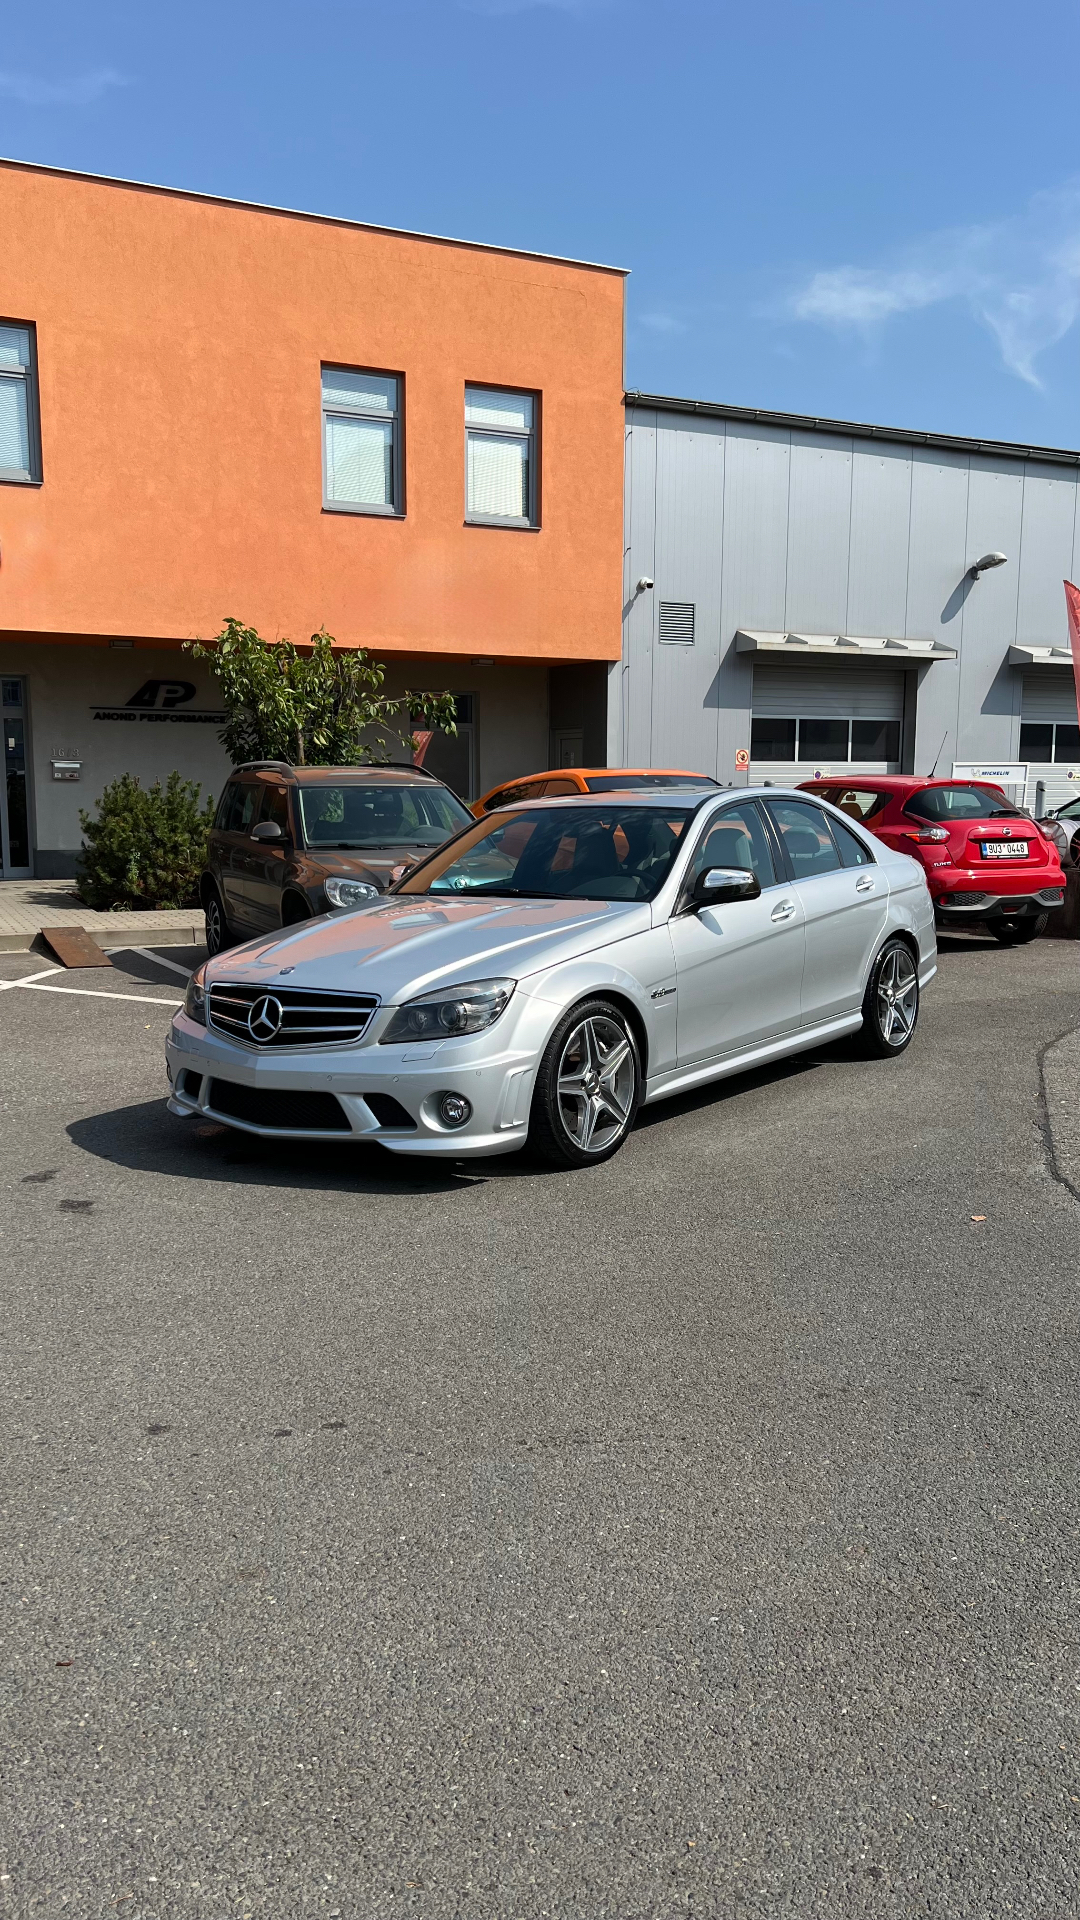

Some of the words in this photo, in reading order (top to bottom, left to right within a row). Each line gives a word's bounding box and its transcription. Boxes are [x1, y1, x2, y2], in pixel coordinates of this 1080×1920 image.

[124, 679, 197, 708] AP
[93, 711, 137, 721] ANOND
[139, 713, 227, 724] PERFORMANCE
[988, 844, 1003, 854] 9U3
[1006, 843, 1025, 854] 0448
